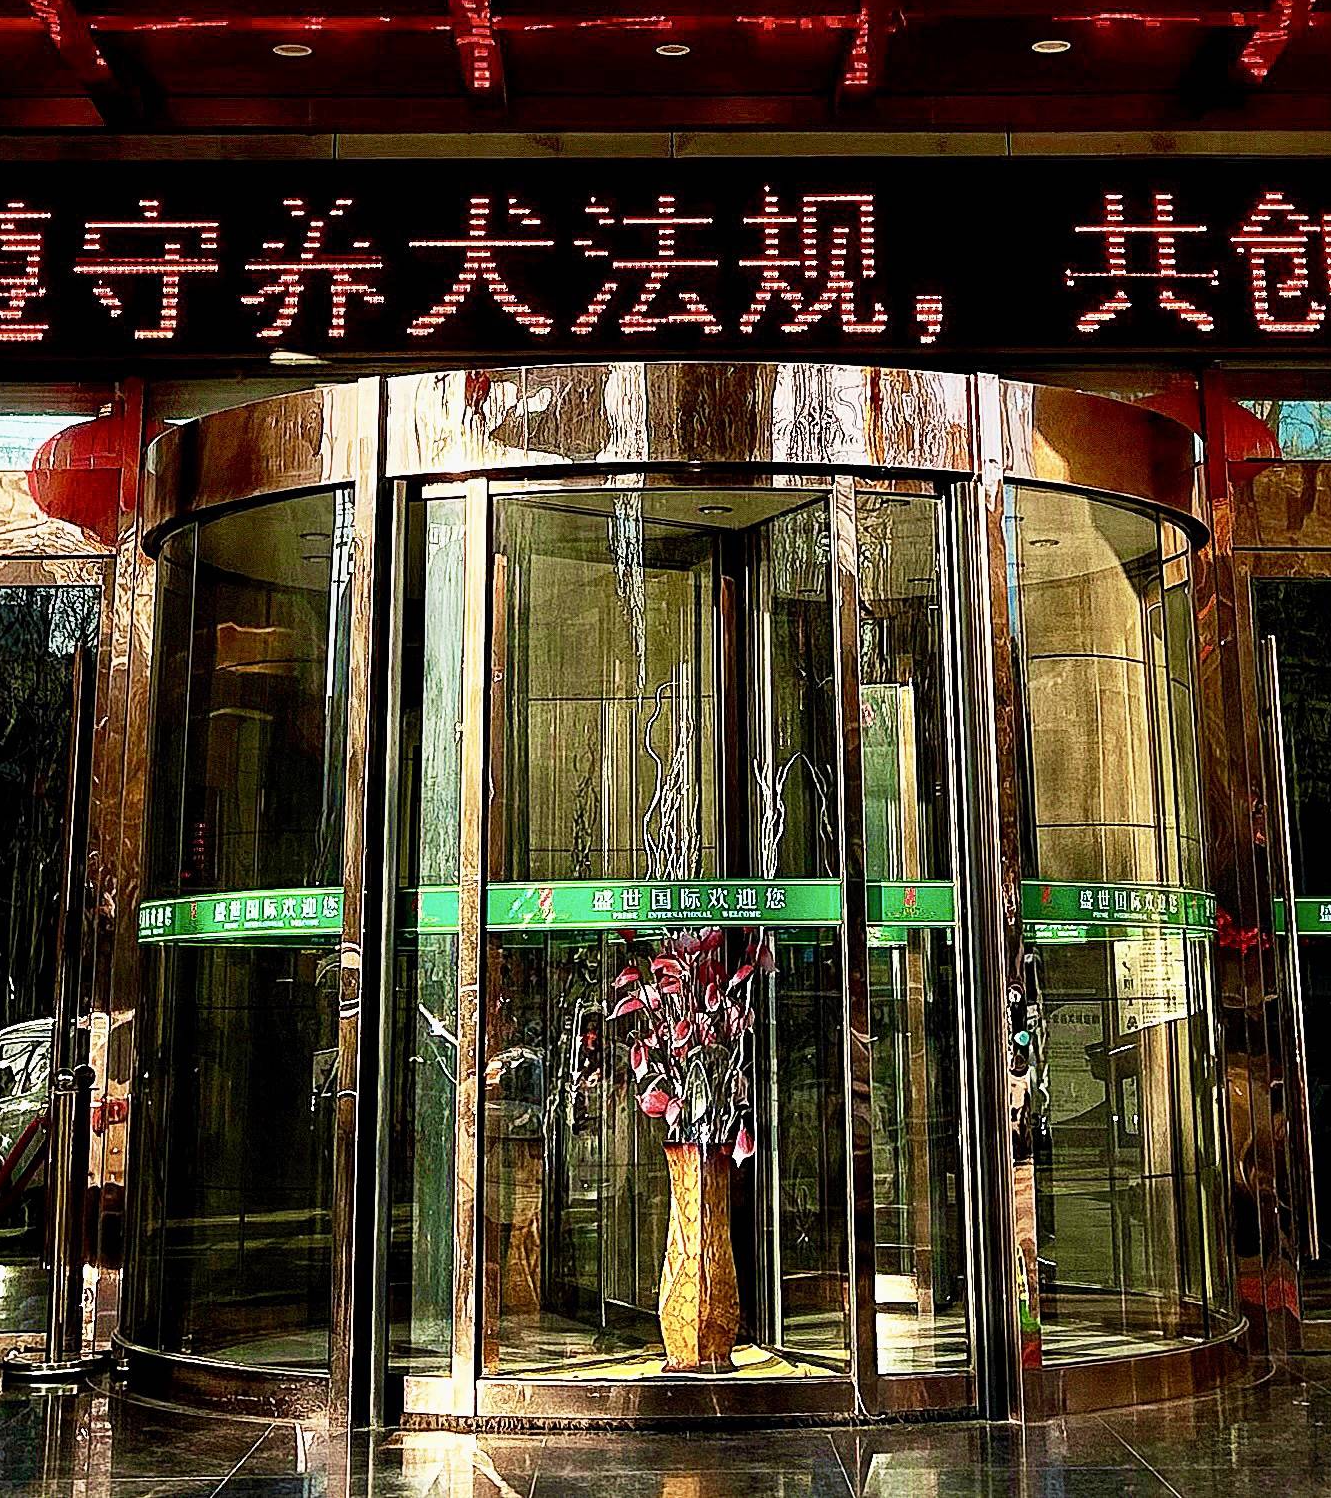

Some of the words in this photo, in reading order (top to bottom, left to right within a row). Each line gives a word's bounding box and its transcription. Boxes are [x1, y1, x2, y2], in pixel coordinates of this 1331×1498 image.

[214, 895, 339, 923] 盛世国际欢迎您
[592, 888, 786, 911] 盛世国际欢迎您
[721, 910, 761, 918] WELCOME
